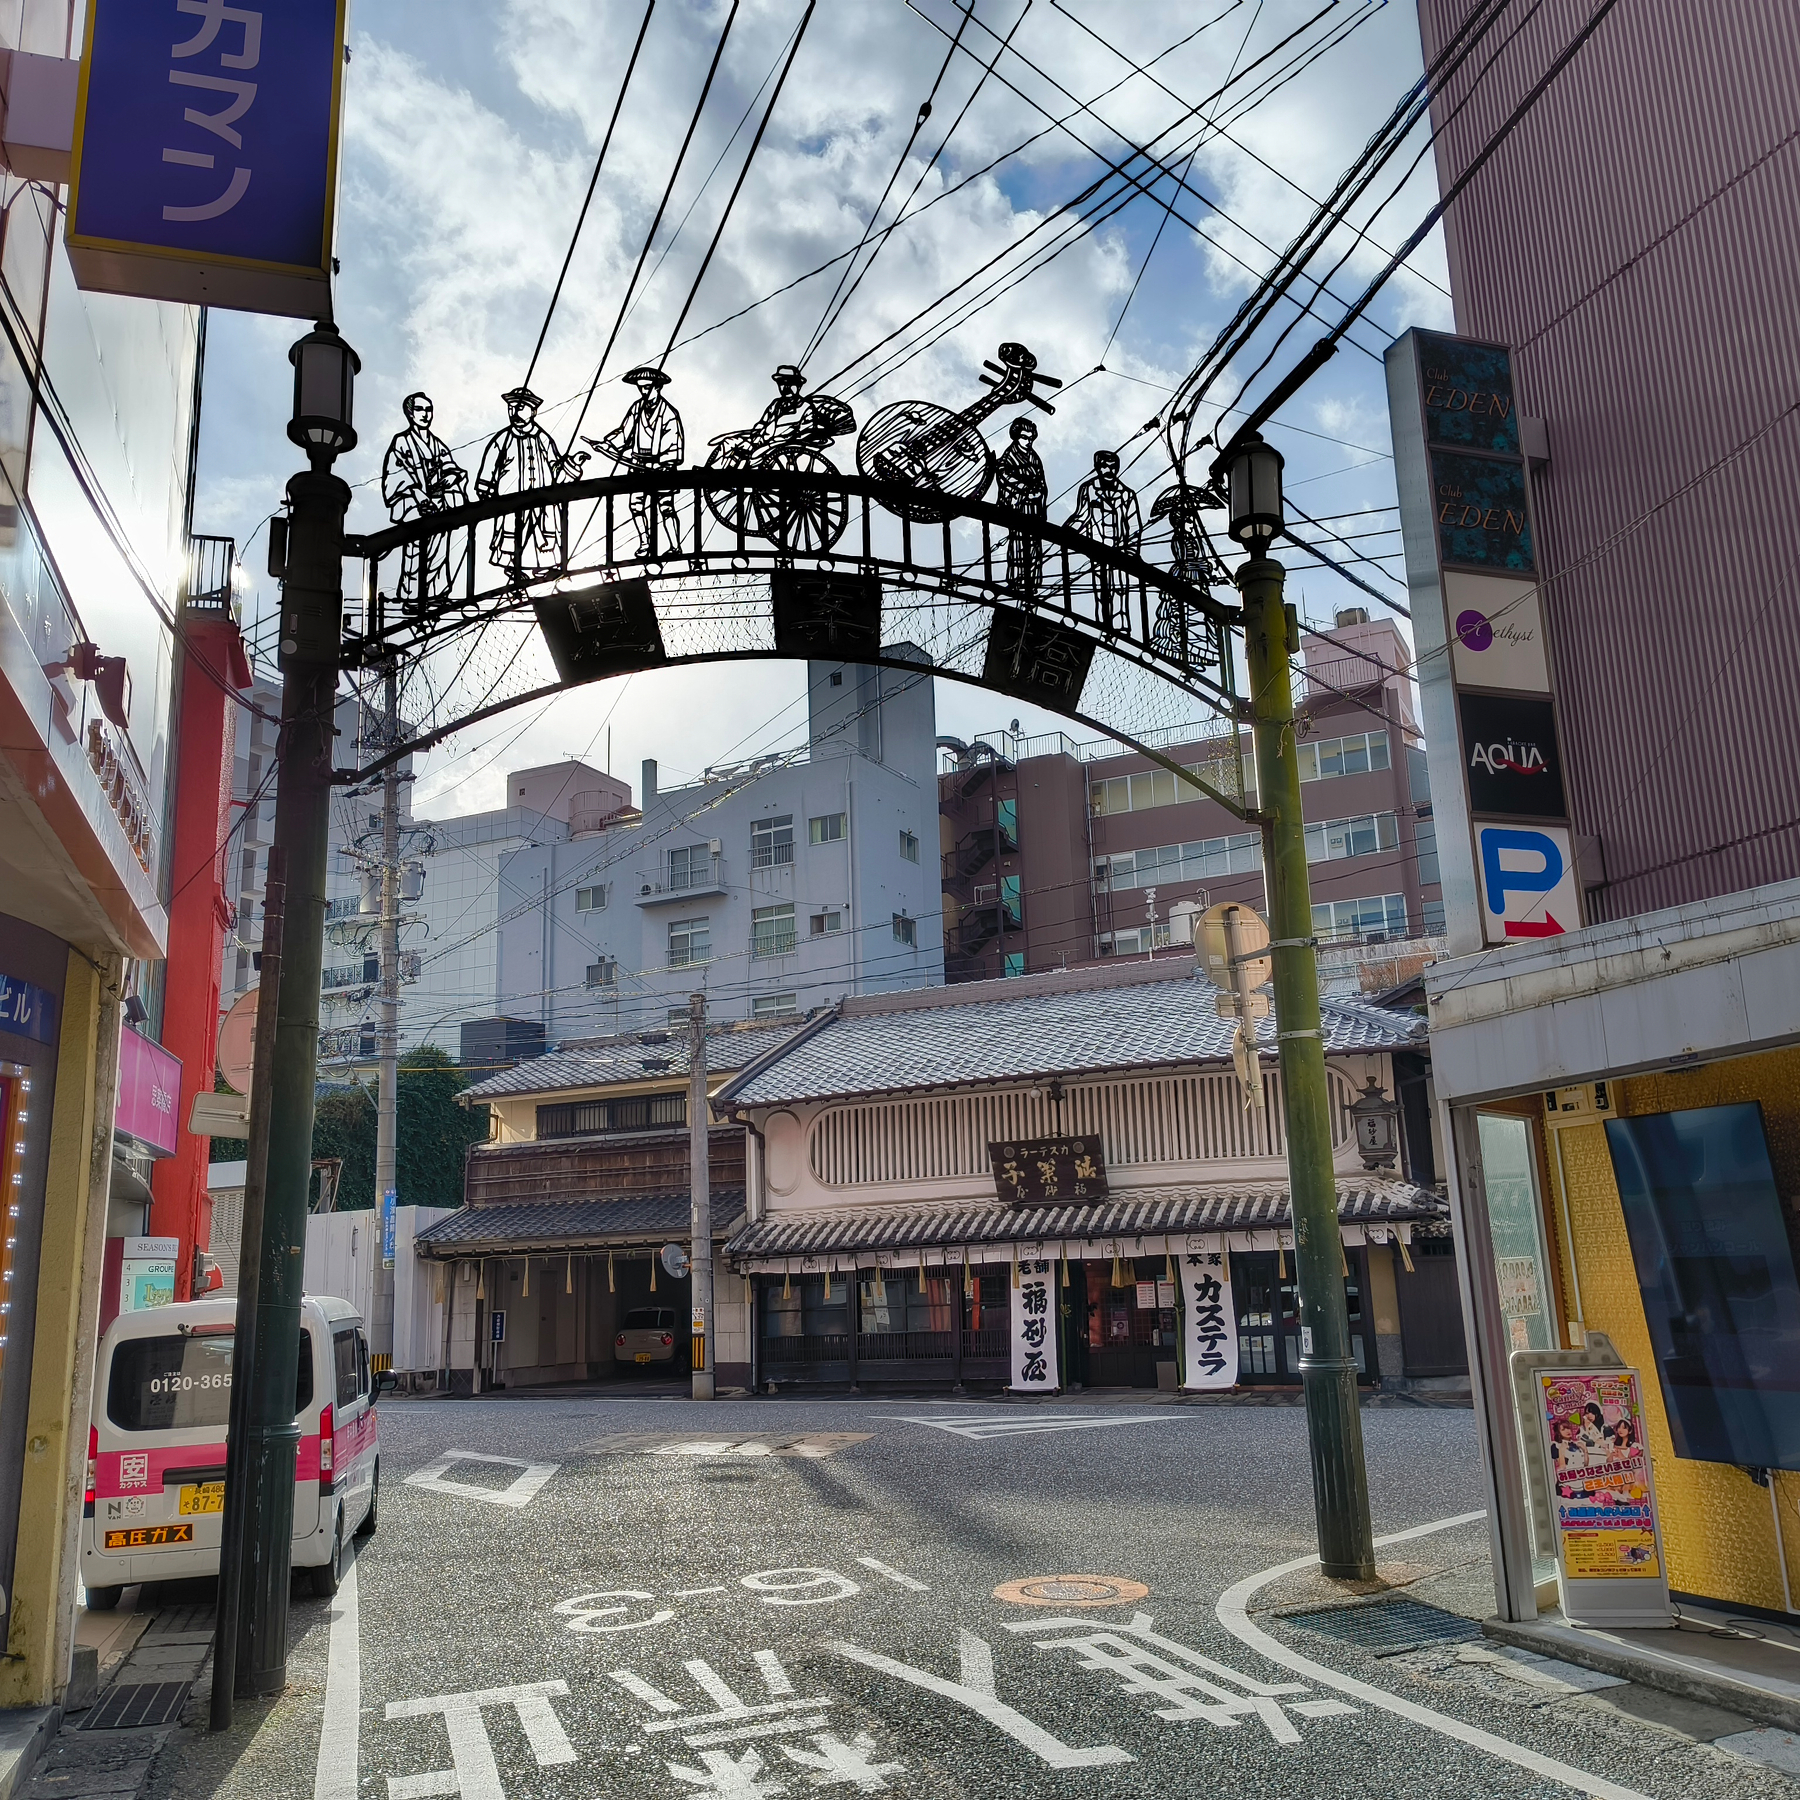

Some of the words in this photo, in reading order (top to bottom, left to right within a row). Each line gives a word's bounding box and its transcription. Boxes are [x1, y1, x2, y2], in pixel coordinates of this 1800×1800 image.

[1426, 367, 1449, 382] Club
[1425, 384, 1511, 419] EDEN
[1439, 484, 1463, 498] Club
[1438, 502, 1525, 535] EDEN
[1470, 737, 1548, 775] AQUA
[1481, 827, 1563, 915] P
[148, 1265, 174, 1273] GROUPE
[126, 1279, 130, 1287] 3
[124, 1294, 129, 1302] 3
[1020, 1281, 1048, 1382] 福砂屋
[1194, 1273, 1228, 1376] カステラ
[123, 1457, 145, 1479] 安
[119, 1481, 147, 1489] カクヤス
[108, 1502, 121, 1515] N
[108, 1525, 188, 1547] 高圧ガス
